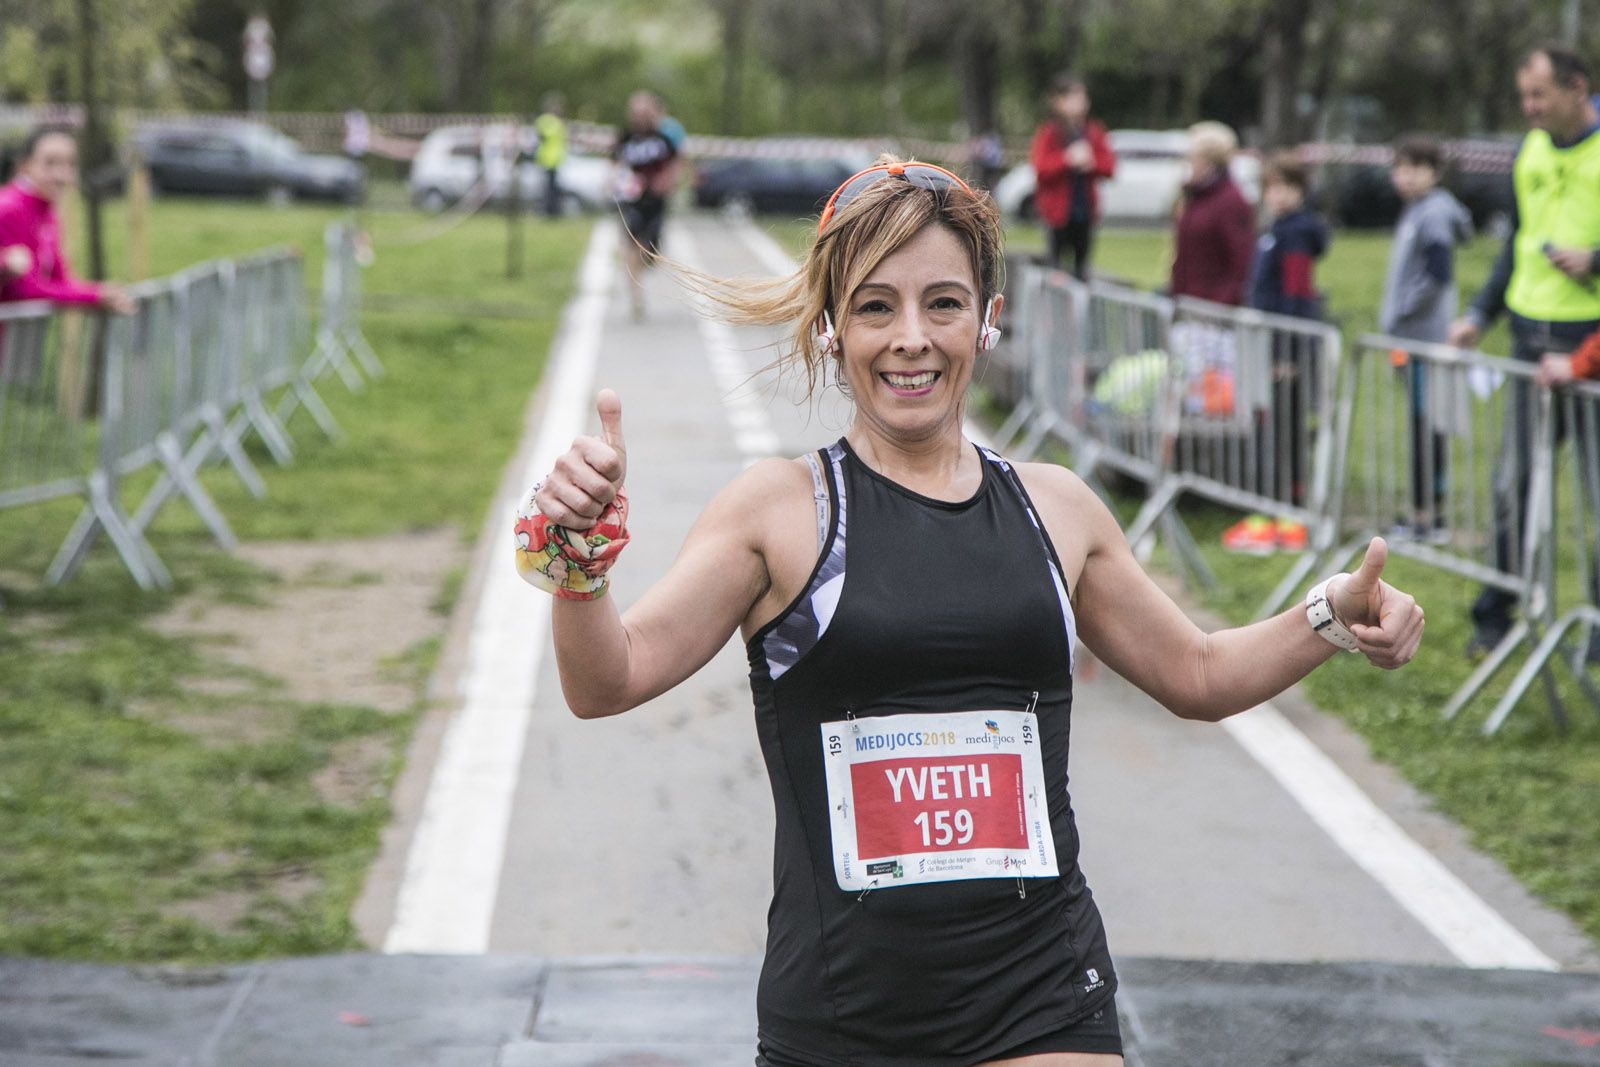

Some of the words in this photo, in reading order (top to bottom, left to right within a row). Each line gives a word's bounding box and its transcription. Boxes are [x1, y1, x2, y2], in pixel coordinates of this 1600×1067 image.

[829, 735, 842, 756] 159
[1022, 725, 1033, 745] 159
[885, 763, 992, 803] YVETH
[914, 809, 974, 847] 159
[1034, 821, 1047, 865] GUARDA-ROBA
[842, 852, 851, 880] SORTEIG
